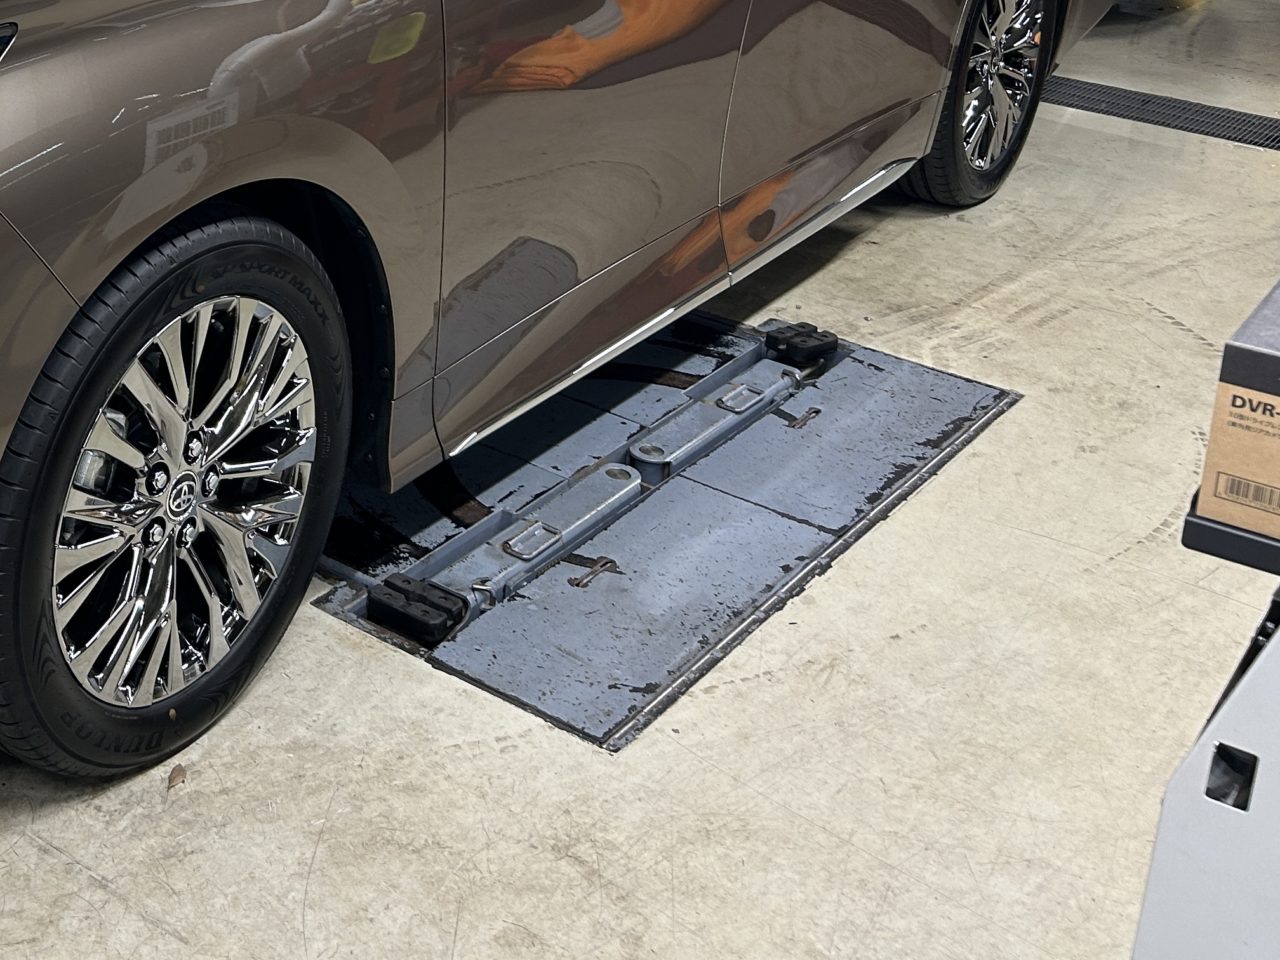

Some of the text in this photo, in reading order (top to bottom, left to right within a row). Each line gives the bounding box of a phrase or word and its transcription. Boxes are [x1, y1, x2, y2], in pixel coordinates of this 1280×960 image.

[239, 261, 290, 280] SPORT
[290, 274, 330, 326] MAXX
[61, 711, 164, 753] DUNLOP
